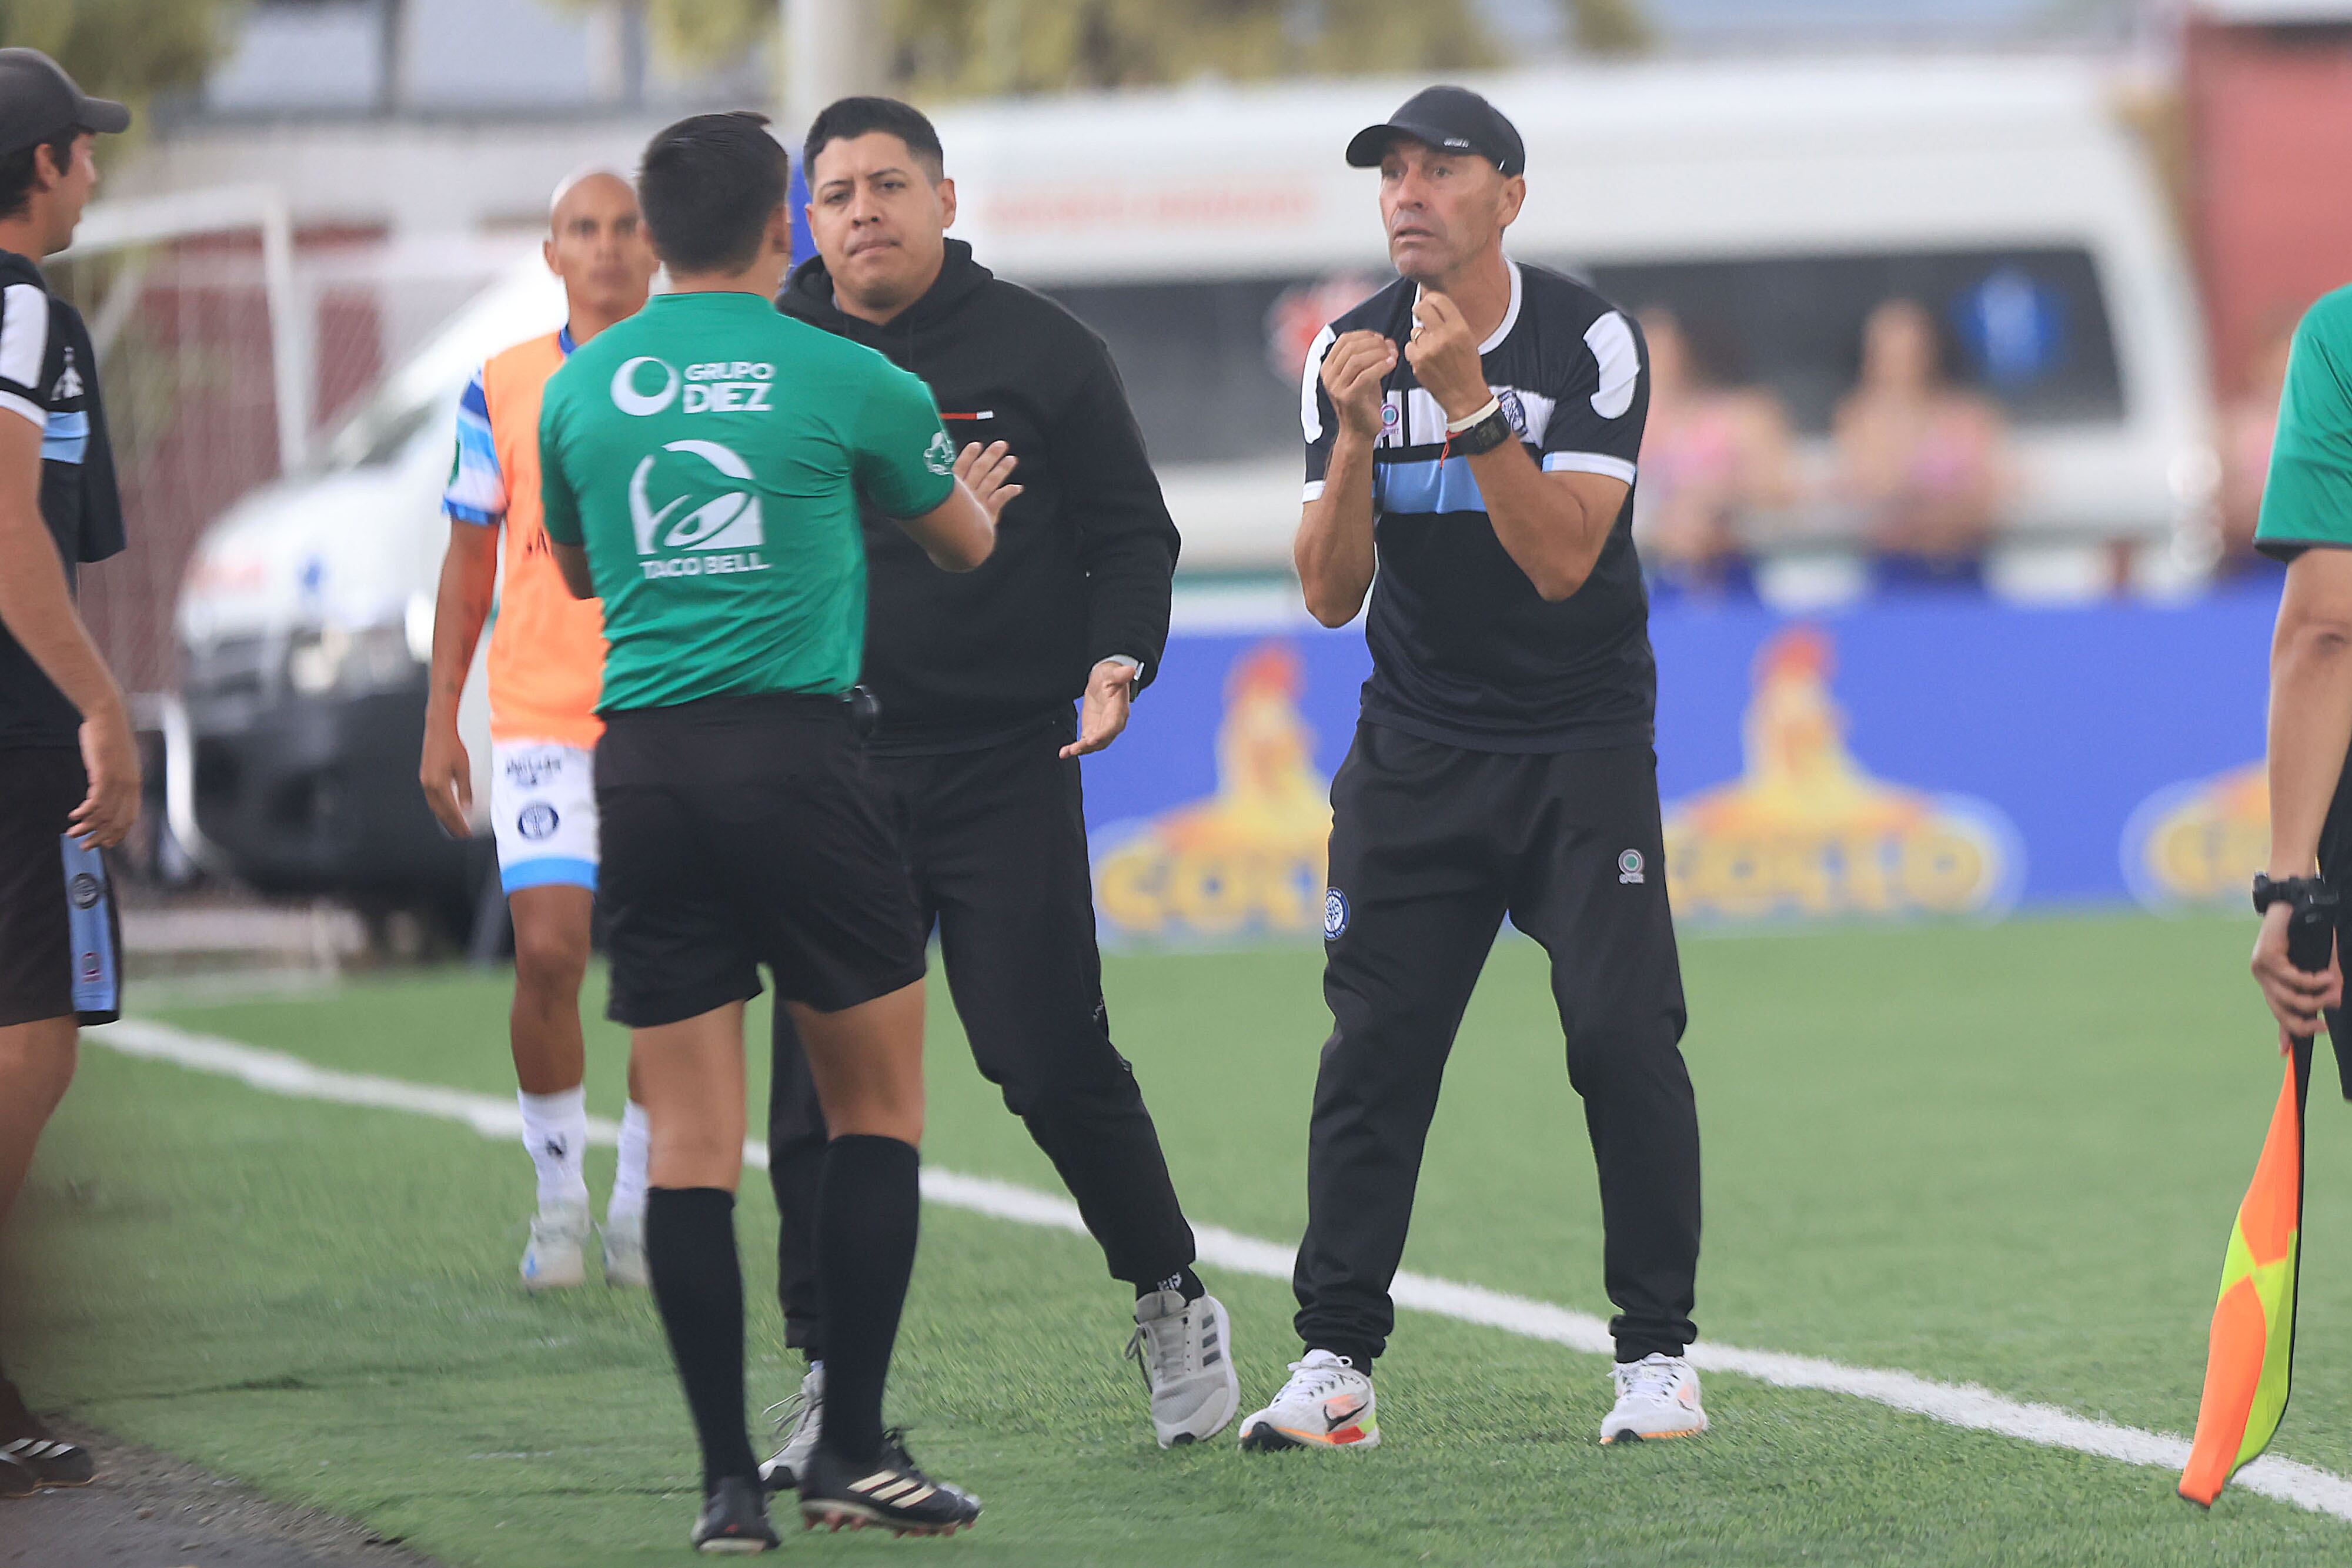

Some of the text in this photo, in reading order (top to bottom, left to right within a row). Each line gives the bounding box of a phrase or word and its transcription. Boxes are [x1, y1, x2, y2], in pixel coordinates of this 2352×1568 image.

[684, 362, 775, 381] GRUPO
[682, 382, 773, 414] DIEZ
[639, 553, 771, 579] TACO BELL
